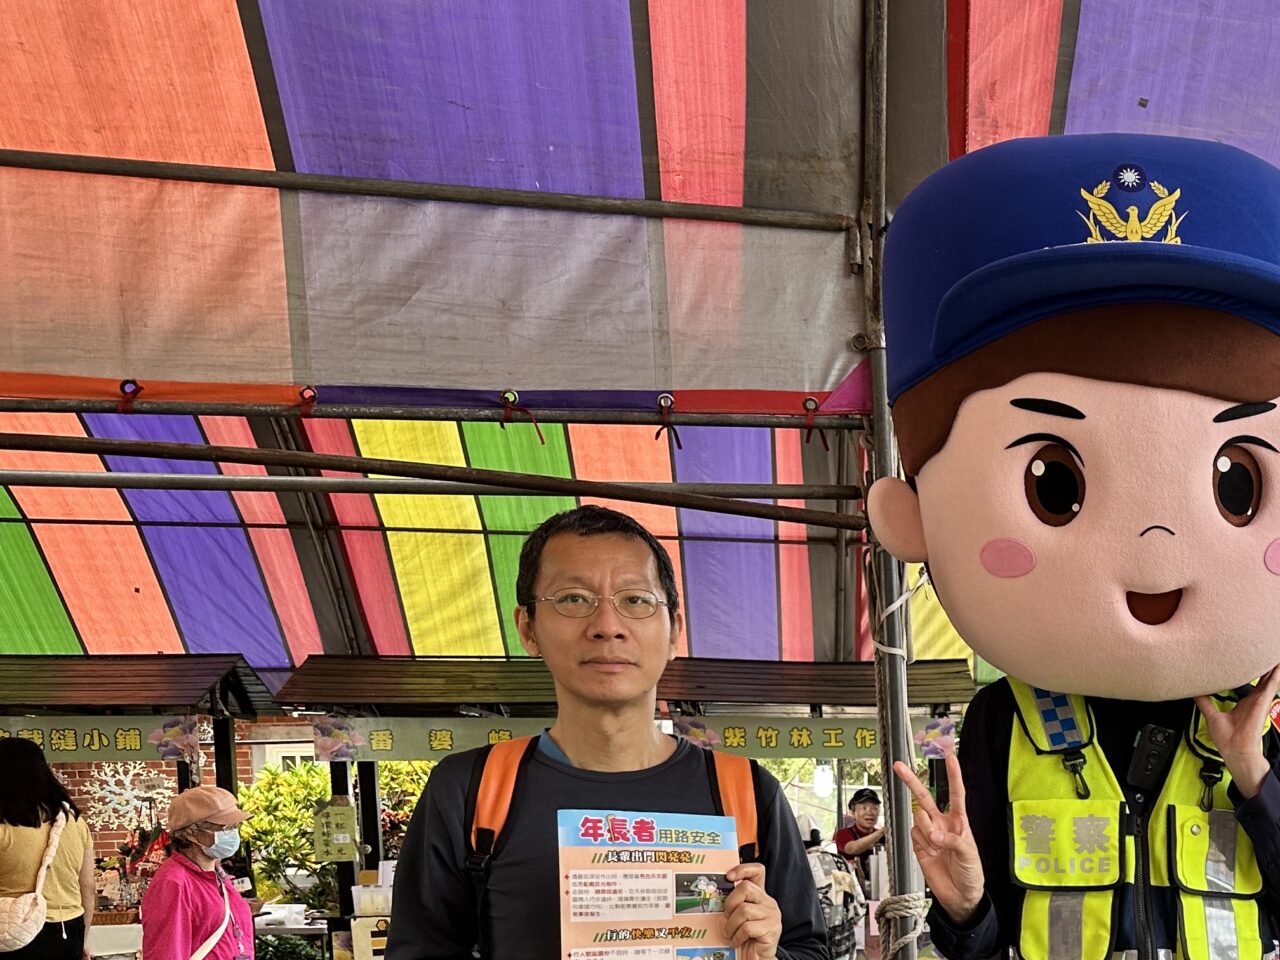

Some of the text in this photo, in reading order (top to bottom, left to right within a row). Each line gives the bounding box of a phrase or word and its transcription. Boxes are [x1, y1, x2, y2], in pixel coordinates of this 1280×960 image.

[580, 816, 721, 845] 年長者 用路安全
[1020, 813, 1111, 854] 警察
[1018, 856, 1111, 873] POLICE
